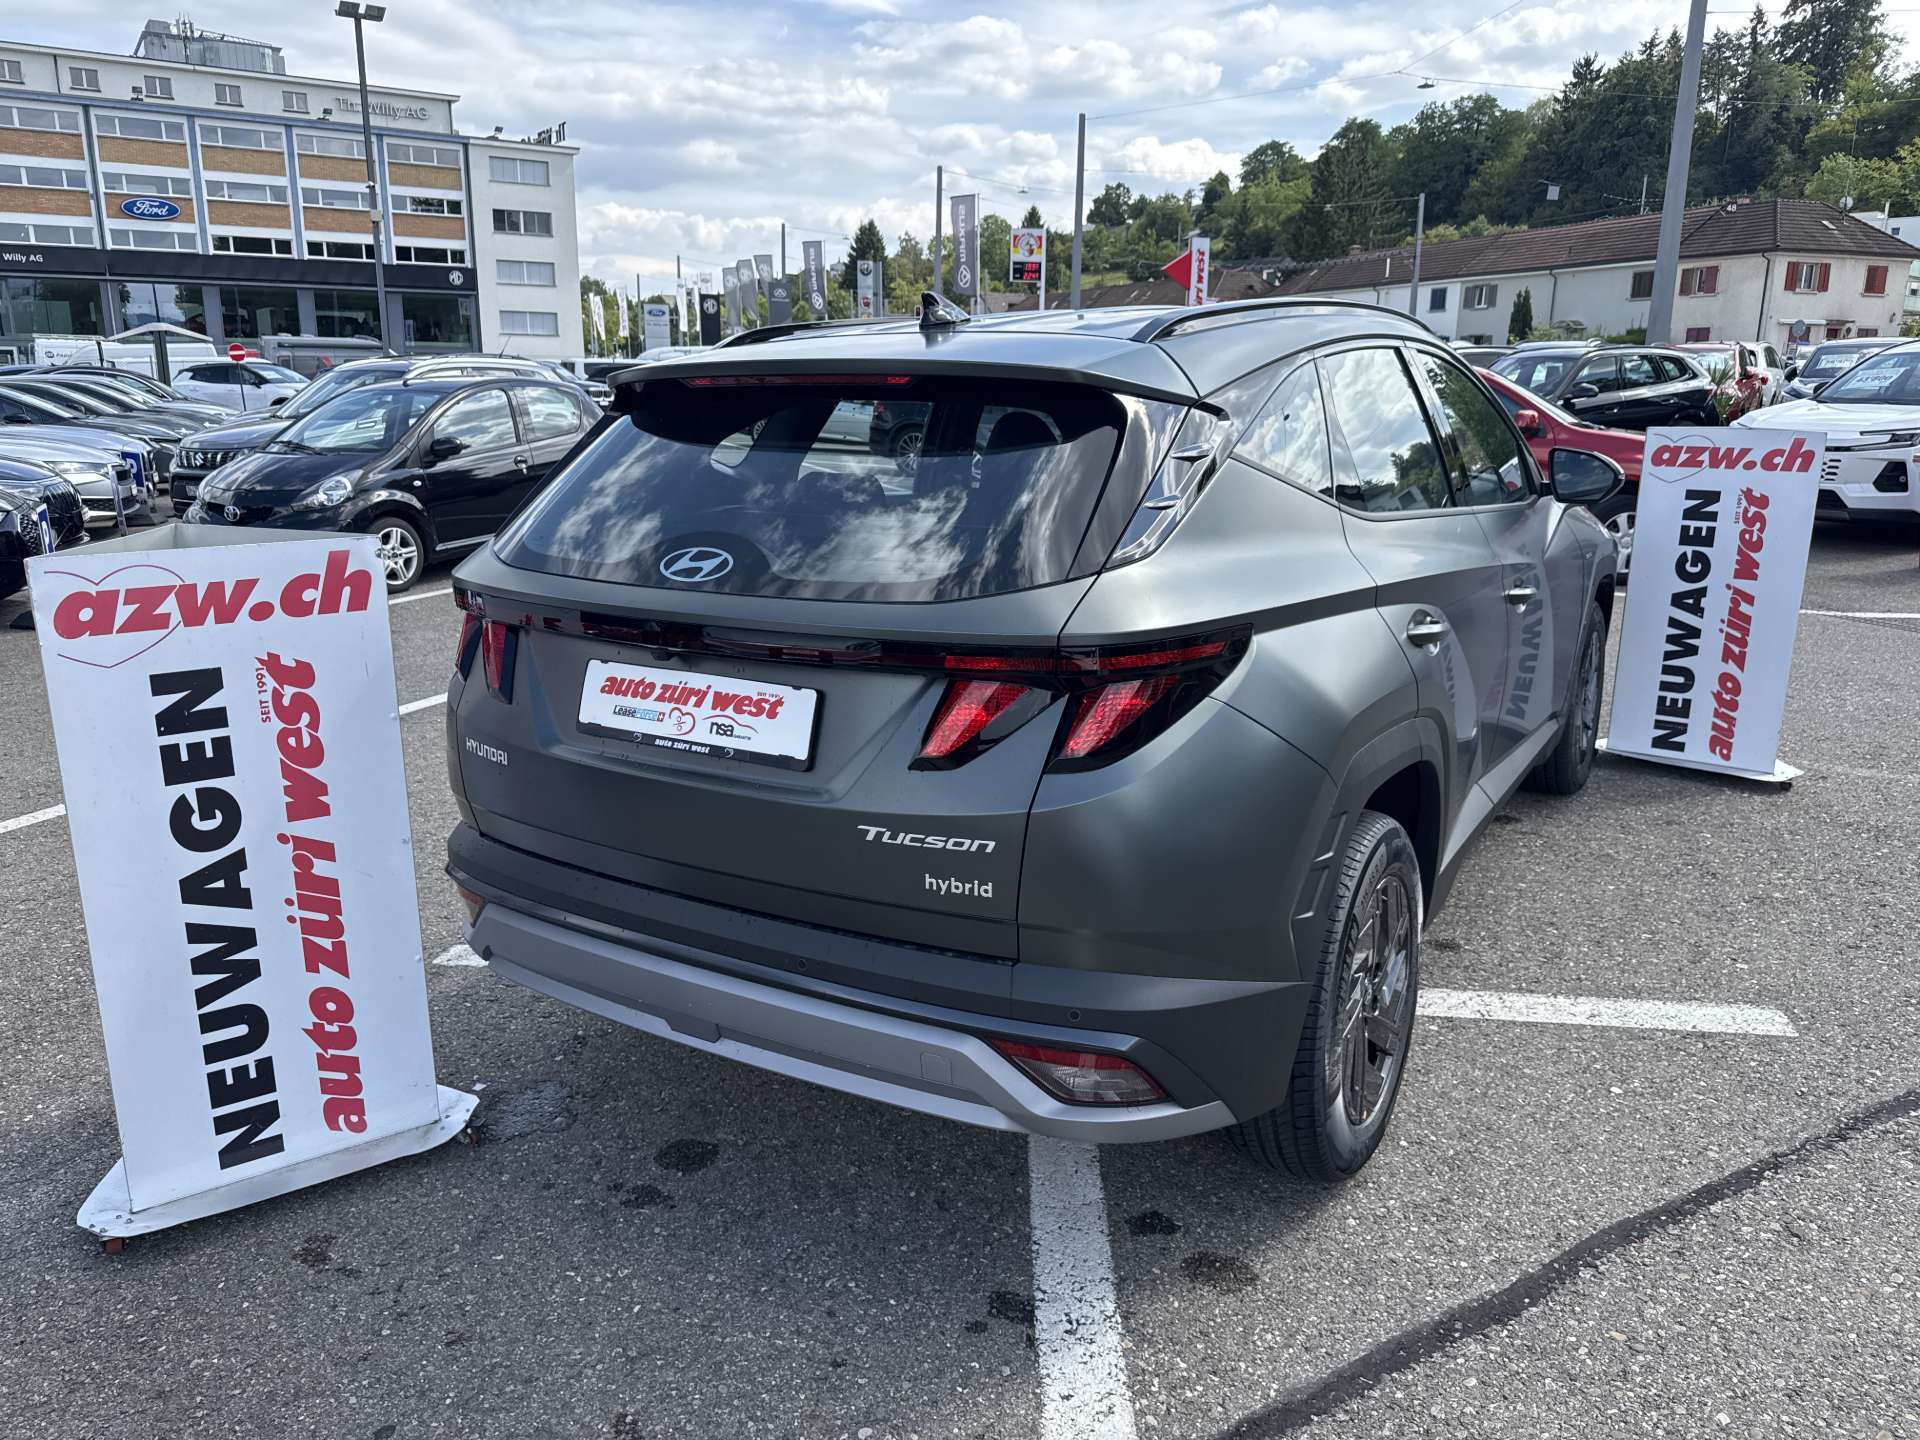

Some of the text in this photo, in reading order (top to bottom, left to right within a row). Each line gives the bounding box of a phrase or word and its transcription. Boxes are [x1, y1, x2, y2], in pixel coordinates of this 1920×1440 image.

[405, 104, 430, 120] AG
[131, 199, 170, 216] Ford
[2, 252, 44, 264] Willy AG
[1651, 438, 1816, 473] azw.ch
[53, 550, 374, 640] azw.ch
[1651, 489, 1722, 753] NEUWAGEN
[1708, 487, 1770, 762] auto züri west
[256, 667, 271, 723] SEIT 1991
[600, 675, 785, 720] auto züri west
[654, 738, 711, 754] auto züri west
[709, 721, 734, 737] nsa
[465, 737, 508, 766] HYUNDAI
[255, 651, 368, 1135] auto züri west
[924, 873, 993, 898] hybrid
[149, 666, 286, 1169] NEUWAGEN
